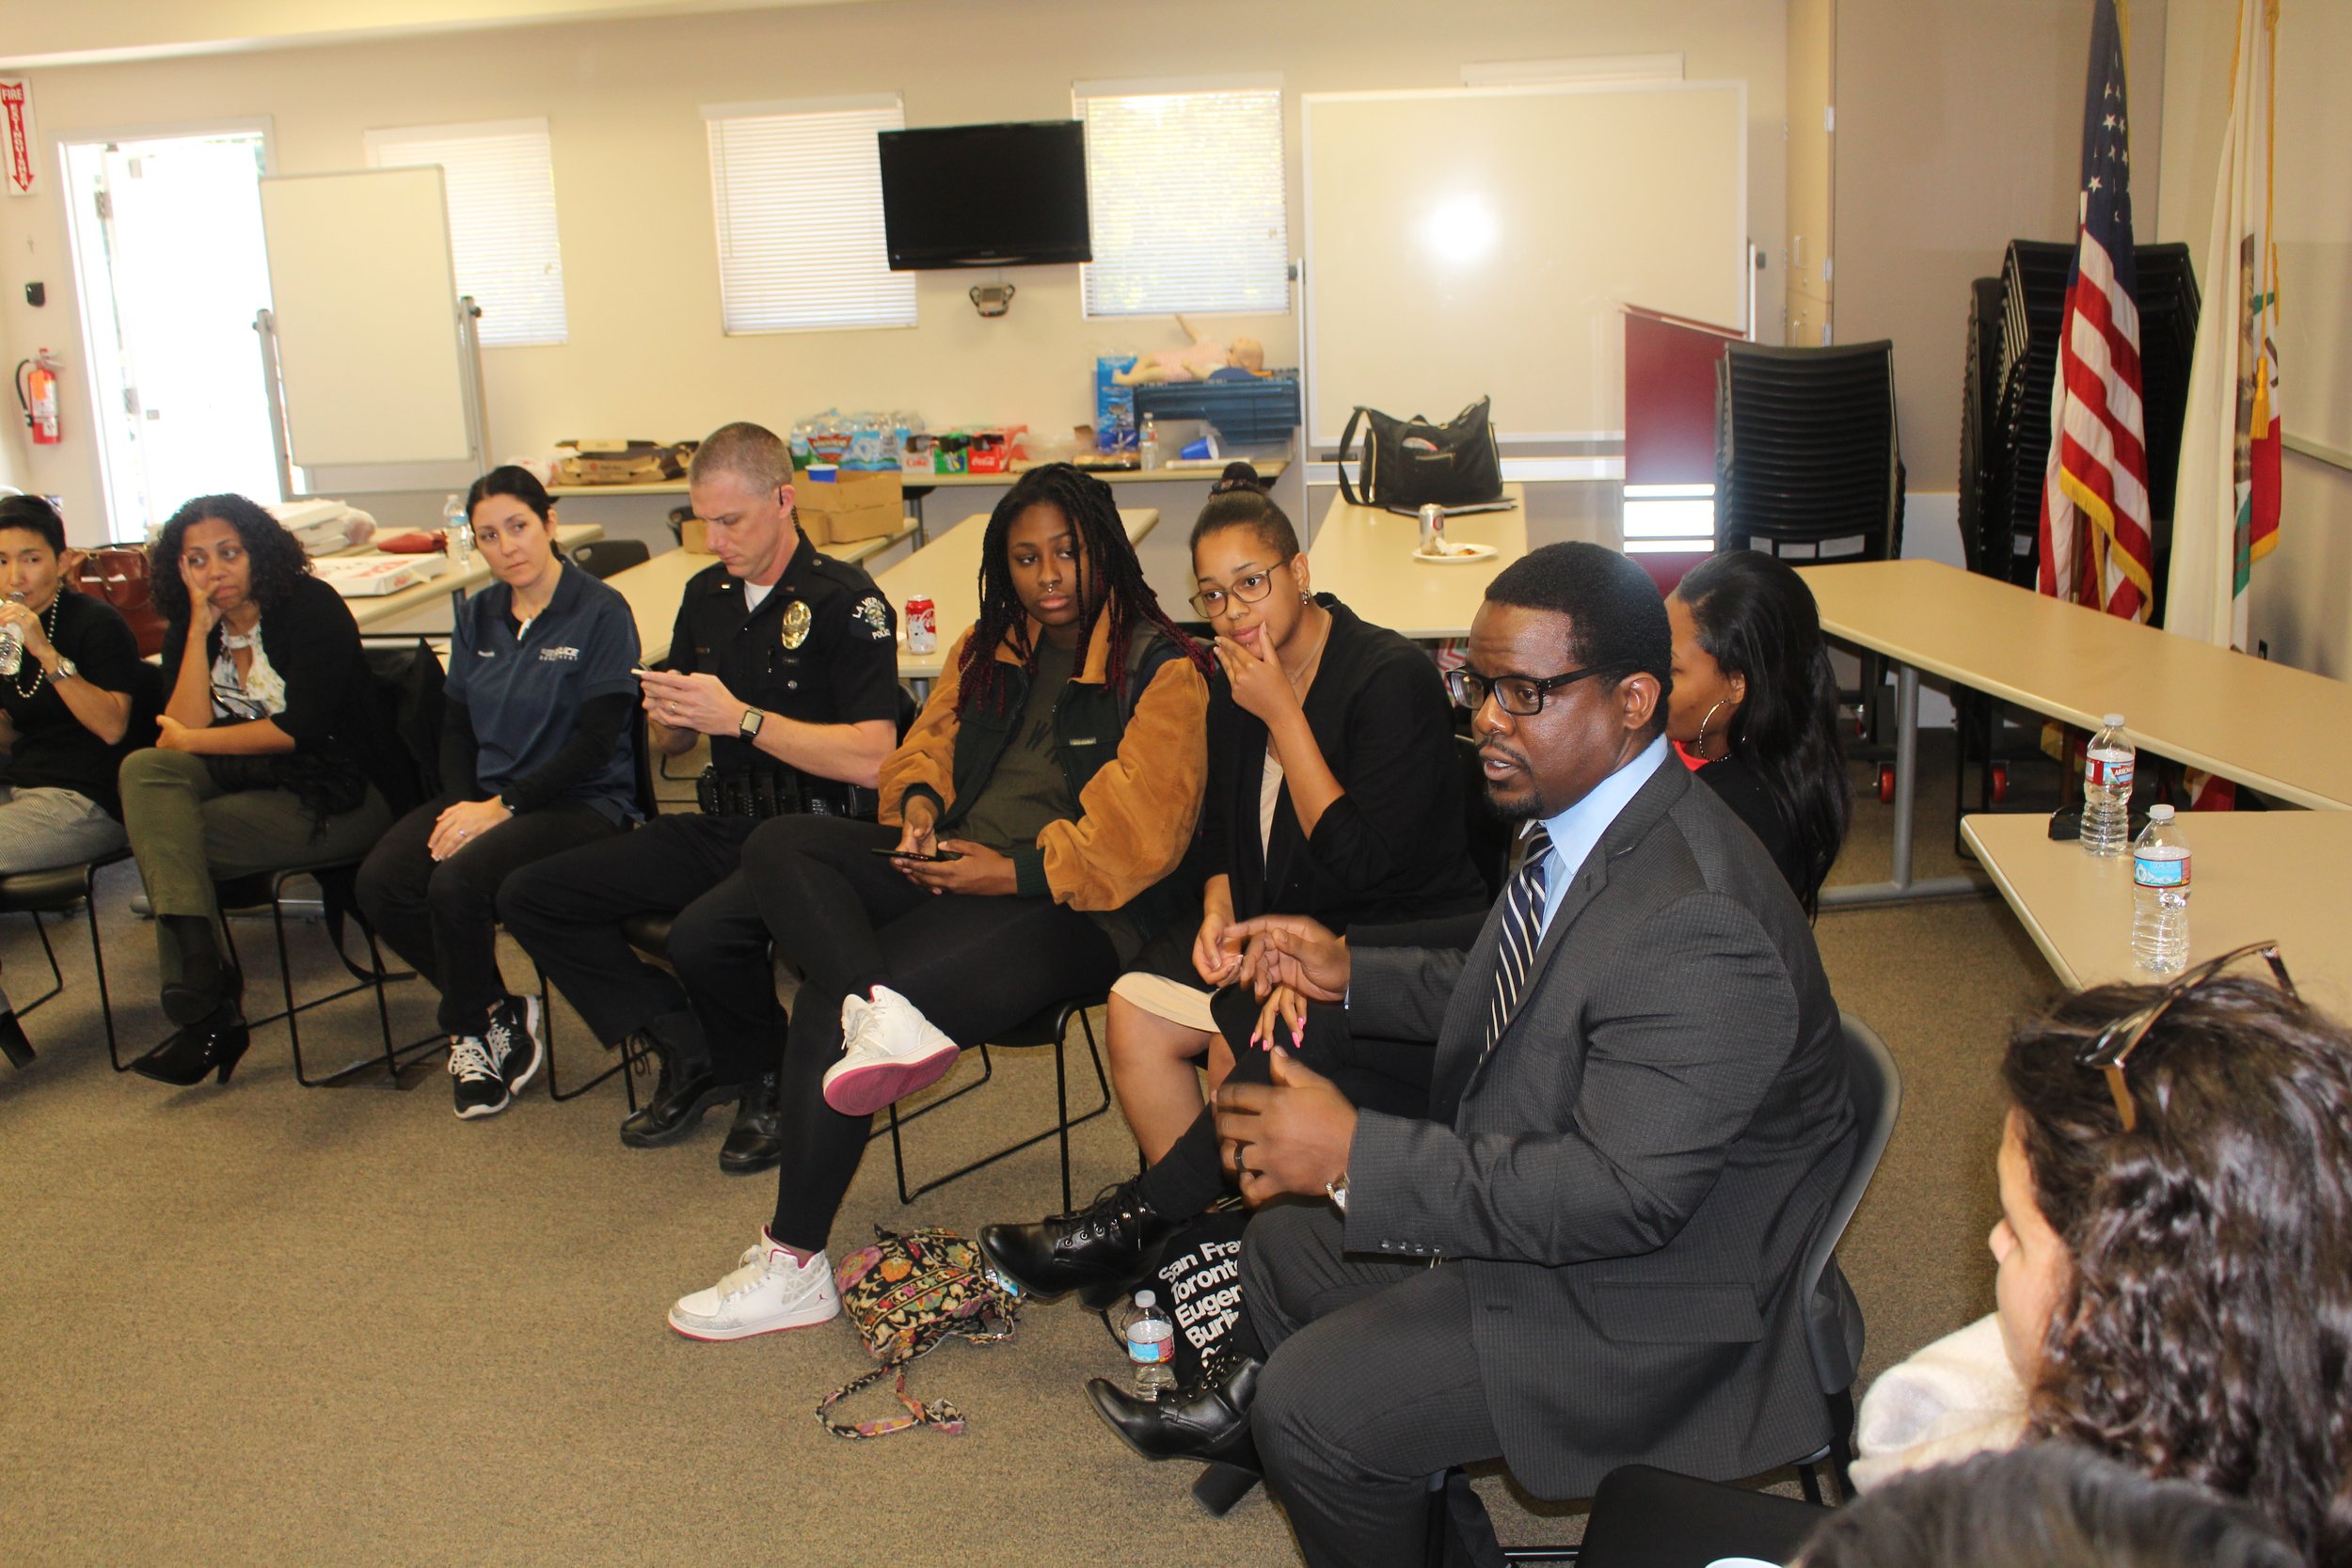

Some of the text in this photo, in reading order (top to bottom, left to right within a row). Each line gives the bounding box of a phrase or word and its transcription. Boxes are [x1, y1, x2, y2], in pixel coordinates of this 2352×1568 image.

[2, 87, 23, 100] FIRE
[852, 606, 865, 619] LA
[1158, 1240, 1242, 1284] San Fra
[1185, 1308, 1240, 1350] Burli
